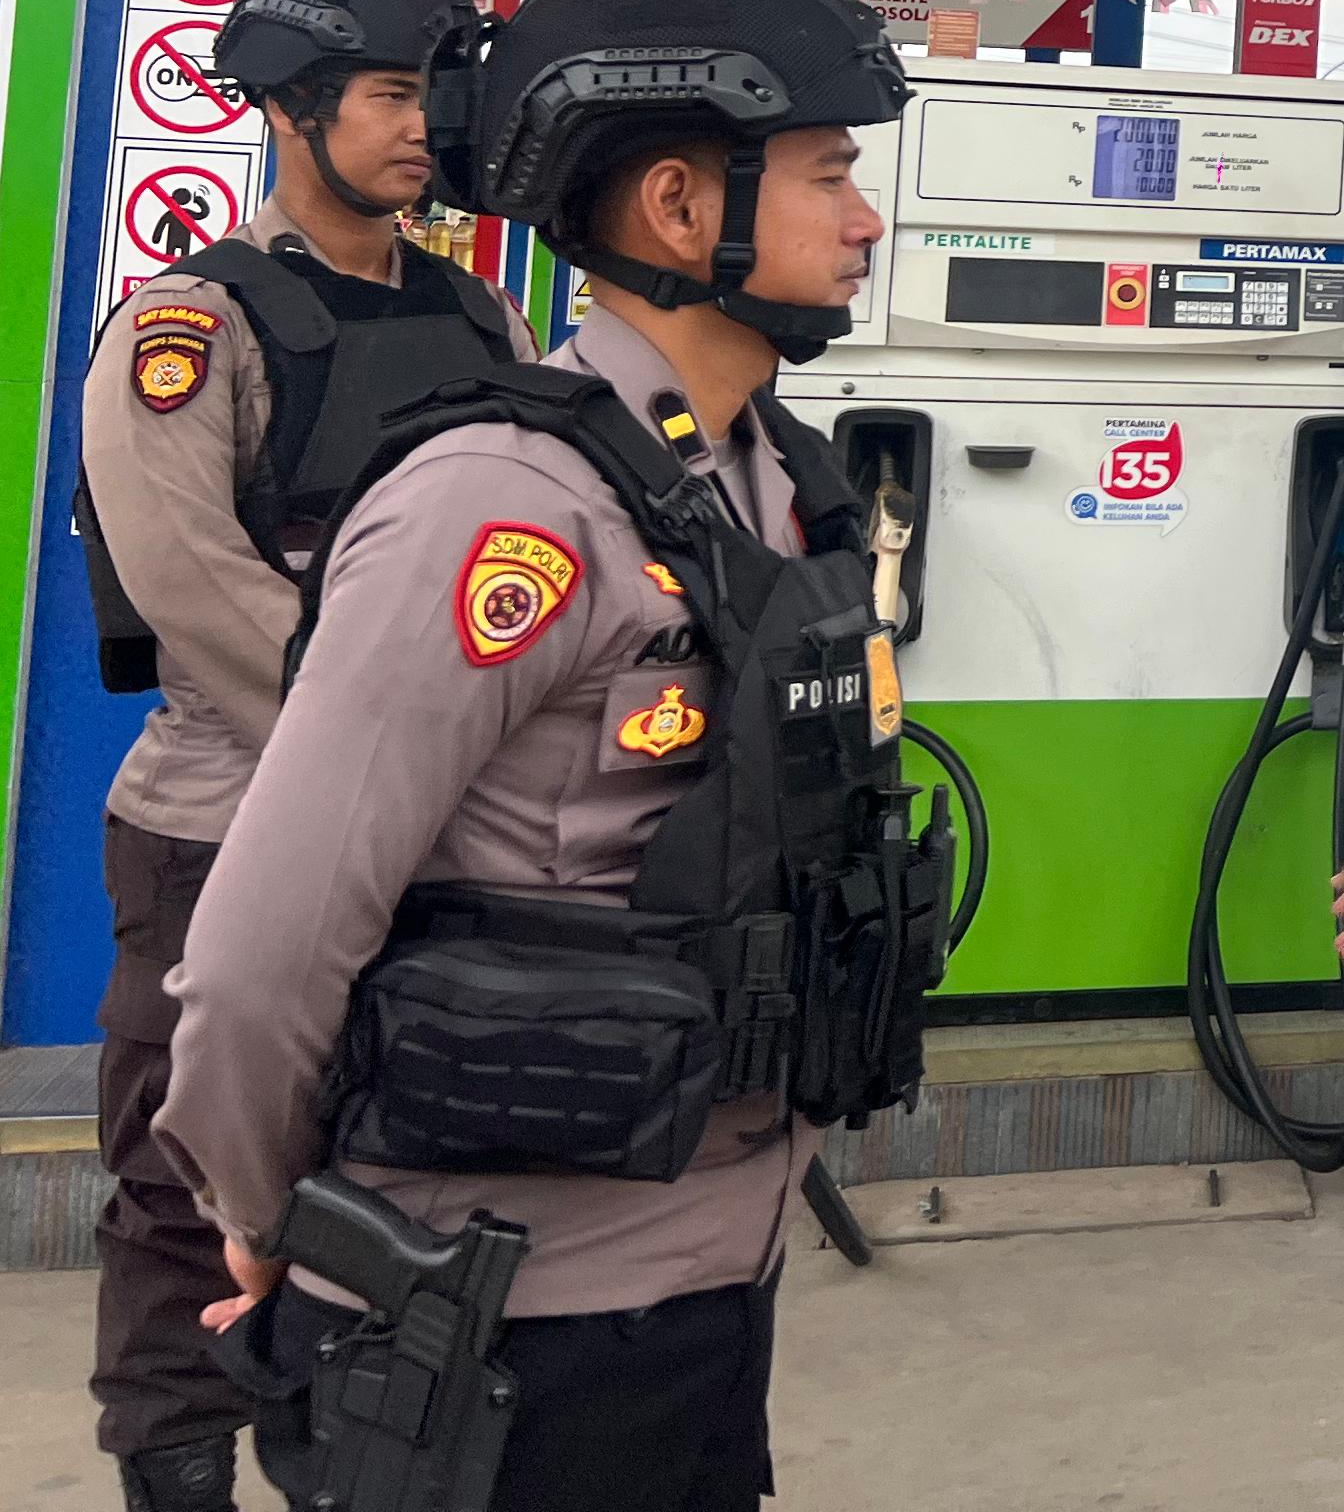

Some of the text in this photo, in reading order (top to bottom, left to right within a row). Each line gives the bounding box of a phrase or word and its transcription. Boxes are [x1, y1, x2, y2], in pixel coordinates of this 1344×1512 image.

[873, 6, 930, 21] OSOL
[1080, 4, 1094, 34] 1
[1249, 26, 1314, 47] DEX
[923, 233, 1032, 251] PERTALITE
[1222, 243, 1328, 261] PERTAMAX
[1104, 429, 1165, 437] CALL CENTER
[1106, 419, 1166, 429] PERTAMINA
[1102, 451, 1171, 490] 135
[492, 536, 571, 584] SDM POLRI
